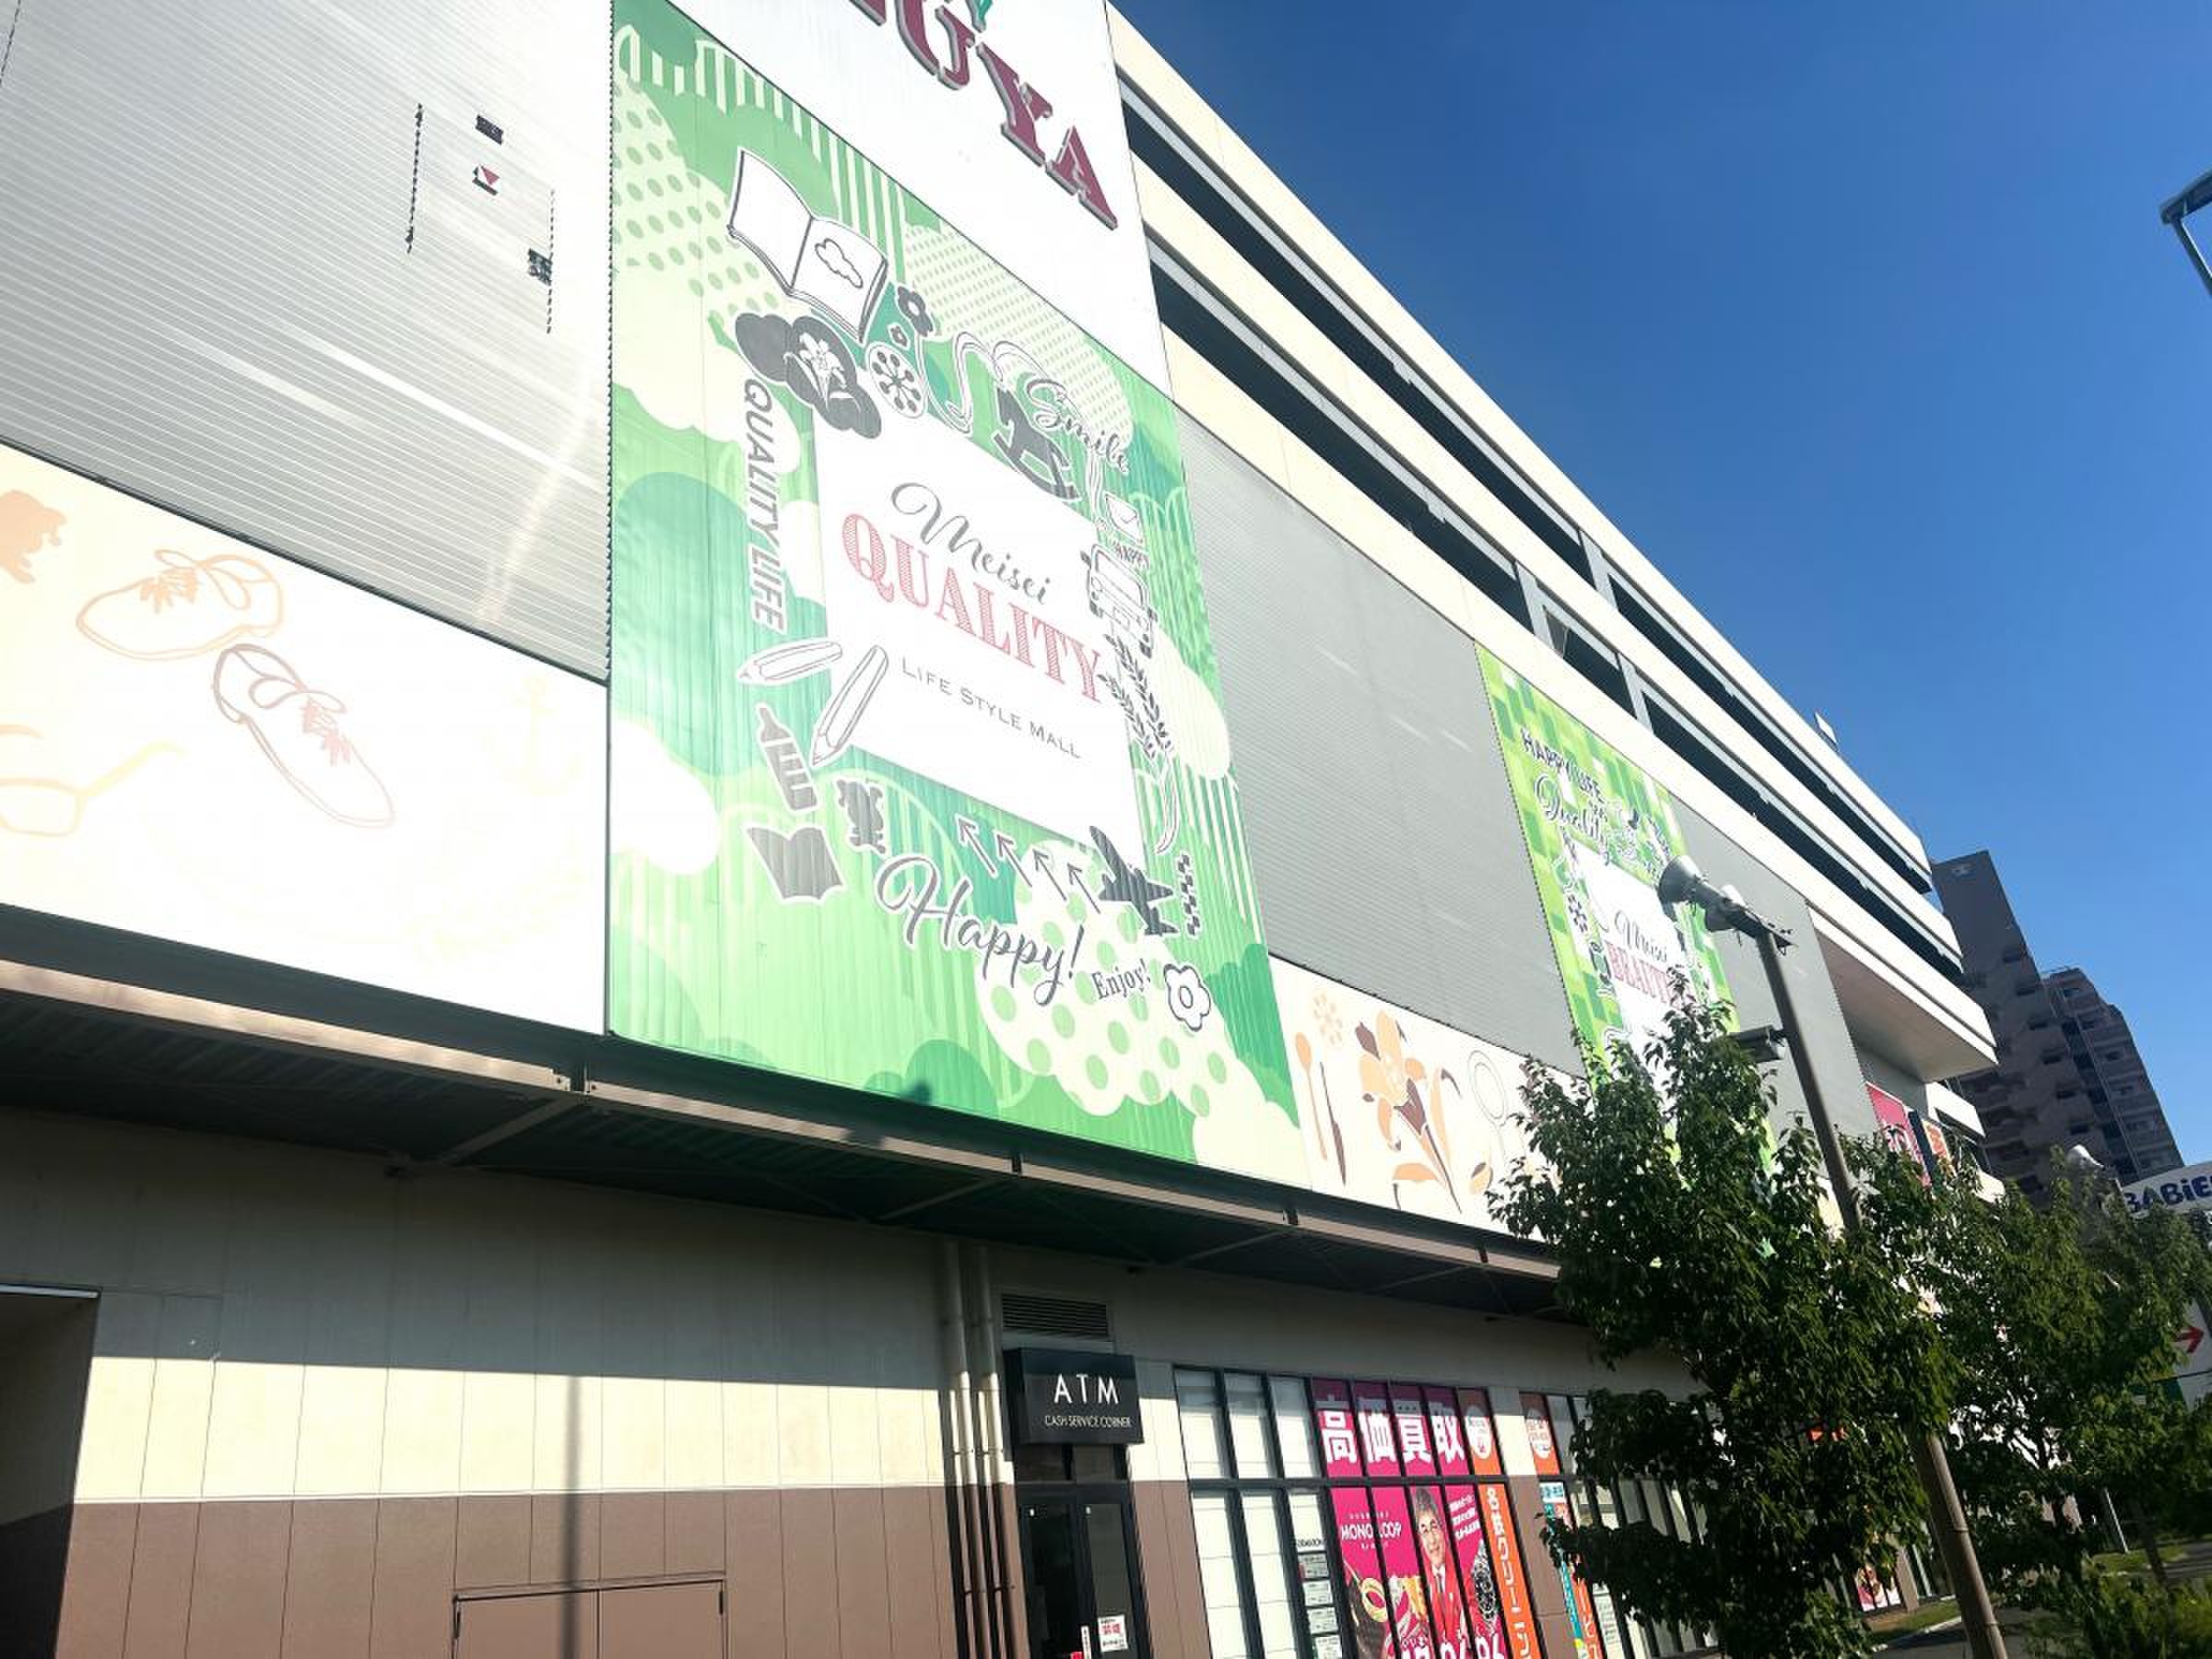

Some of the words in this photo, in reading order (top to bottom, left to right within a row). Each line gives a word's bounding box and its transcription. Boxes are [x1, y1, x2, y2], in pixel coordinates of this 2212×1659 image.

[850, 0, 1118, 230] UYA
[744, 378, 781, 547] QUALITY
[751, 547, 785, 632] LIFE
[841, 513, 1101, 703] QUALITY
[877, 855, 1086, 1006] Happy!
[1091, 958, 1152, 1000] Enjoy!
[1044, 1415, 1067, 1427] CASH
[1053, 1372, 1119, 1405] ATM
[1315, 1394, 1466, 1465] 高価買取
